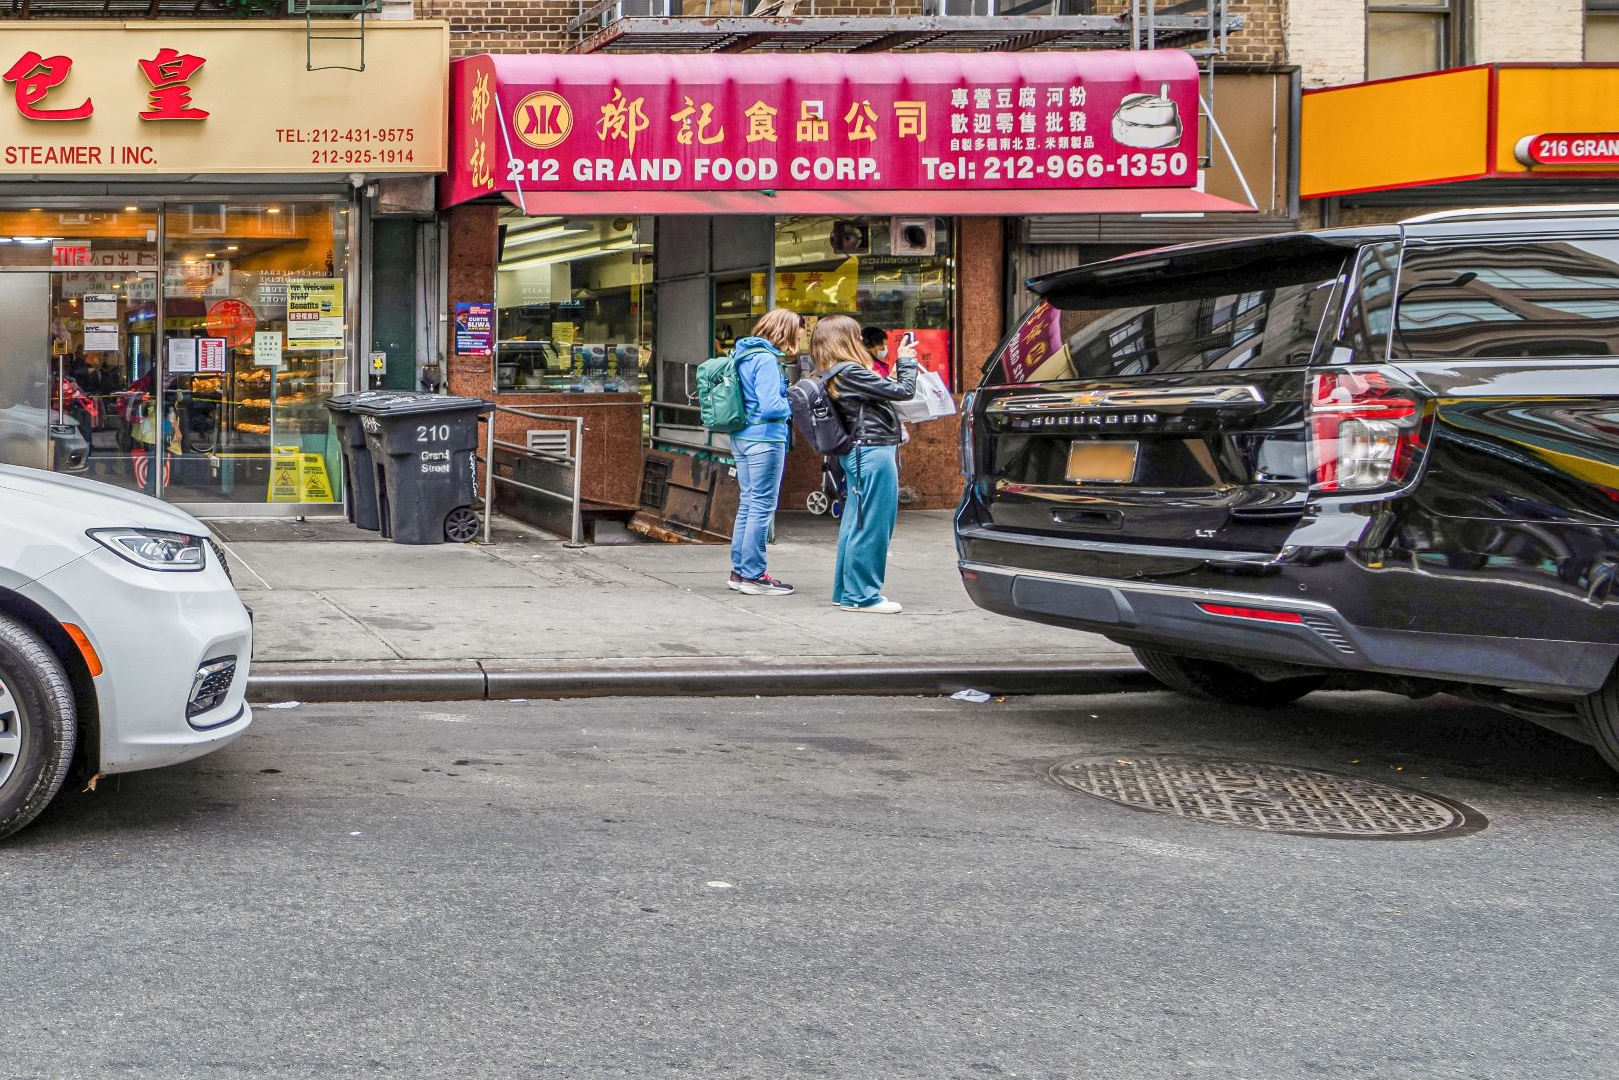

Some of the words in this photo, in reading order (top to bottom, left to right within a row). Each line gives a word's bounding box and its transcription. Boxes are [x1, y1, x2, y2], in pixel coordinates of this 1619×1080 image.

[5, 146, 101, 164] STEAMER
[121, 146, 158, 164] INC.
[1539, 140, 1568, 156] 216
[311, 149, 414, 163] 212-925-1914
[507, 158, 559, 181] 212
[573, 158, 681, 181] GRAND
[694, 157, 778, 181] FOOD
[790, 157, 881, 181] CORP.
[921, 157, 975, 180] Tel:
[984, 152, 1188, 179] 212-966-1350
[1031, 414, 1158, 426] SUBURBAN
[416, 425, 450, 442] 210
[421, 450, 450, 460] Grand
[421, 463, 450, 473] Street
[1195, 529, 1217, 538] LT
